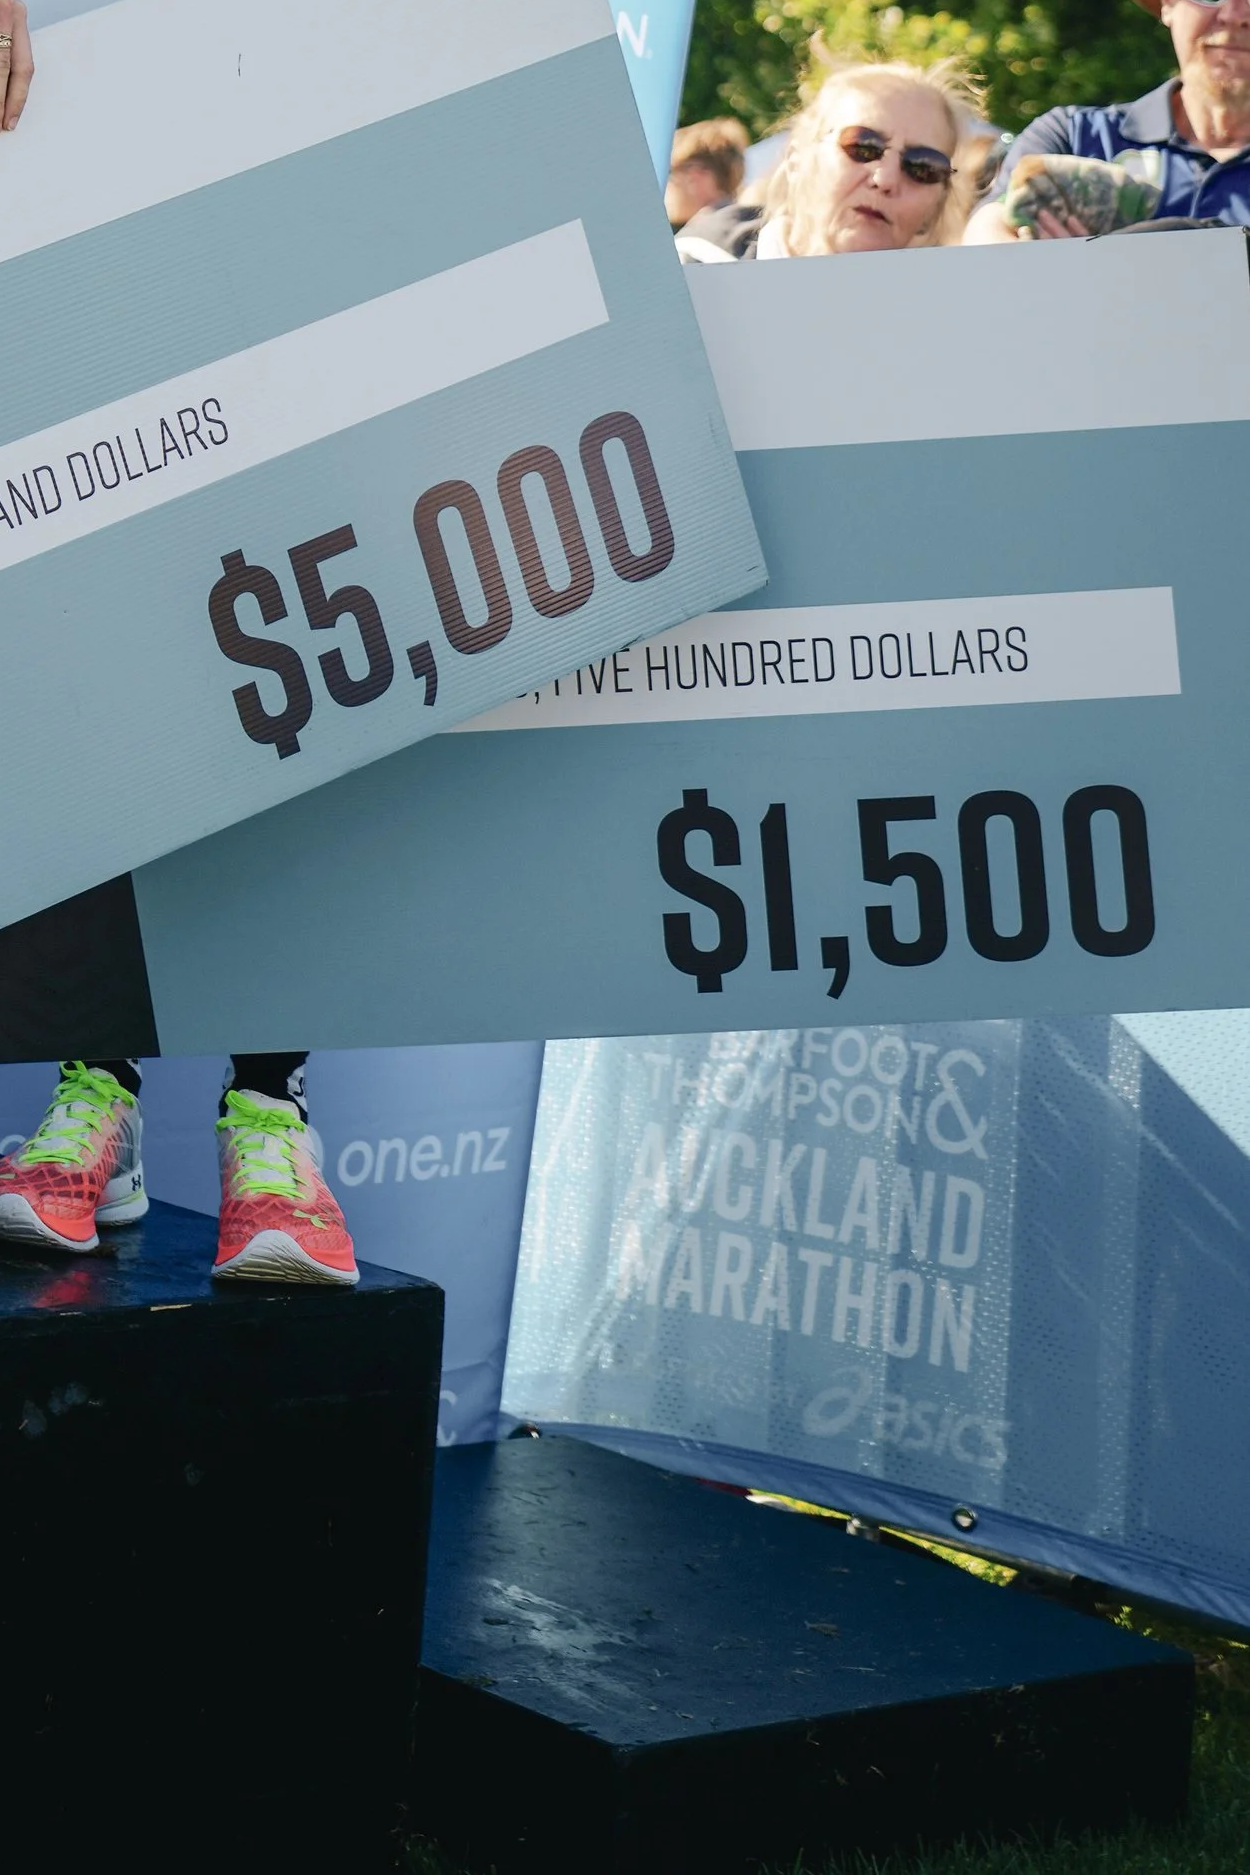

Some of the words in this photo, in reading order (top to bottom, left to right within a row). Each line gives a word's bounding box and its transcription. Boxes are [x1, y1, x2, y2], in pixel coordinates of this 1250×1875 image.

[67, 397, 230, 500] DOLLARS
[208, 410, 676, 760] $5,000
[645, 637, 836, 693] HUNDRED
[850, 625, 1030, 681] DOLLARS
[655, 783, 1156, 1001] $1,500
[337, 1125, 511, 1188] one.nz
[623, 1122, 986, 1270] AUCKLAND
[616, 1223, 977, 1373] MARATHON
